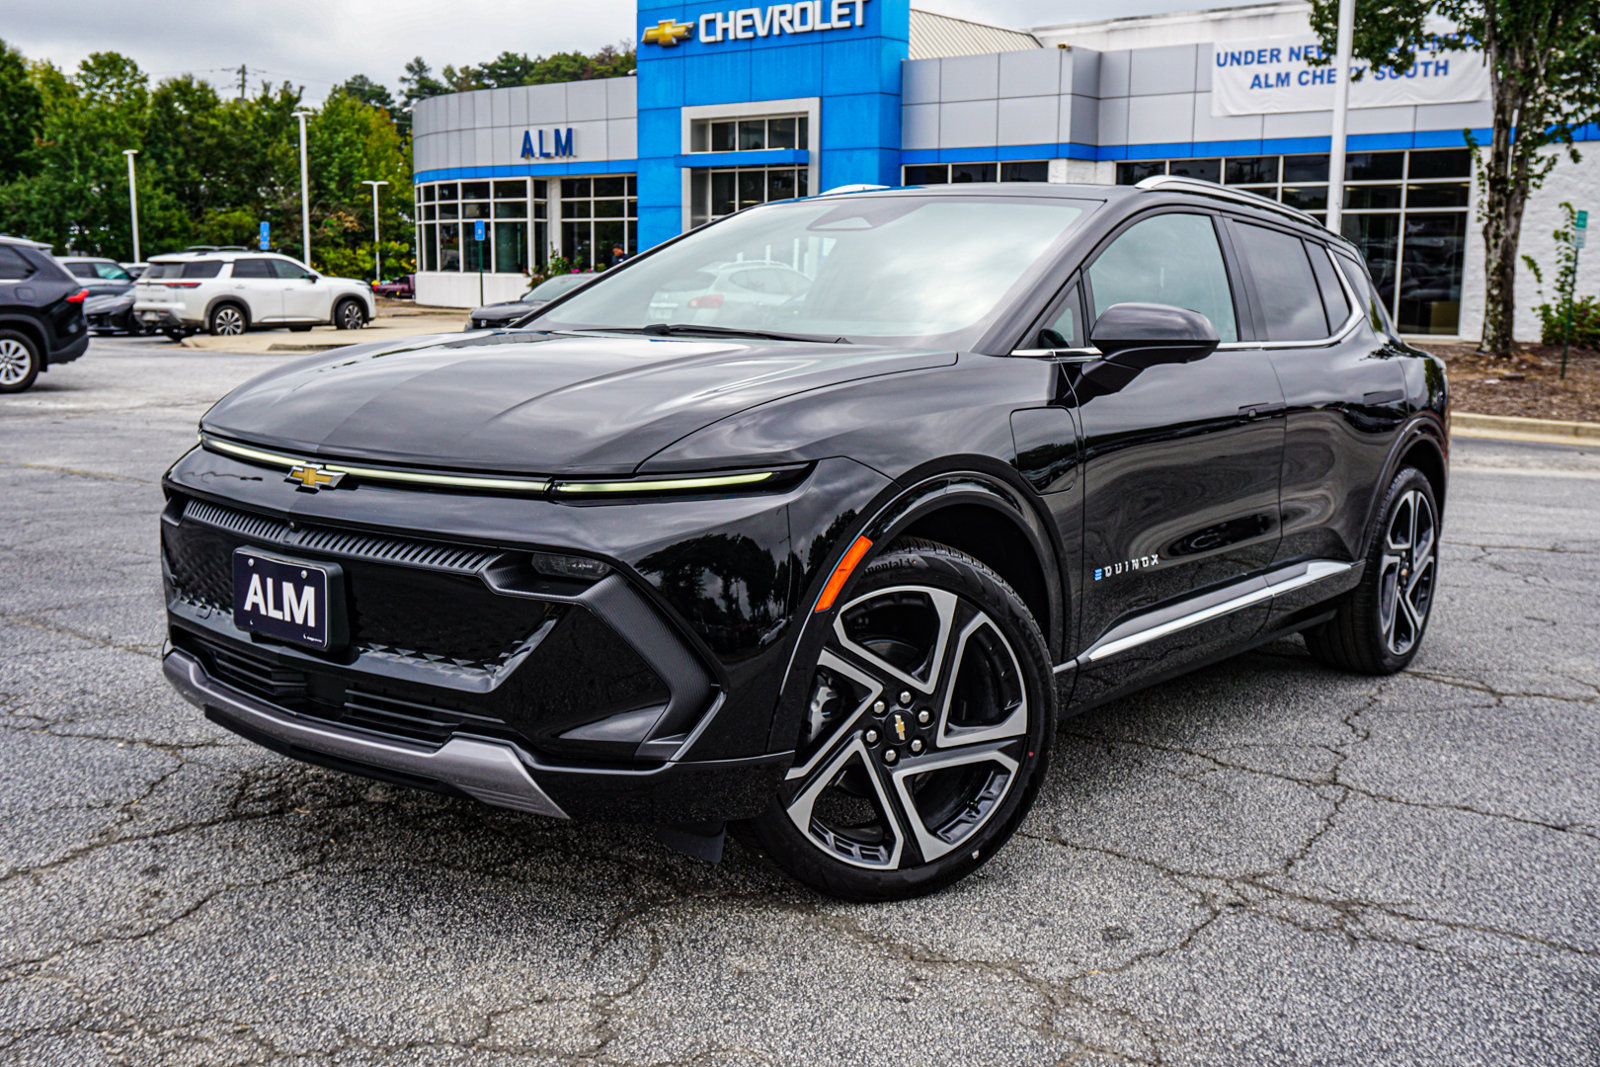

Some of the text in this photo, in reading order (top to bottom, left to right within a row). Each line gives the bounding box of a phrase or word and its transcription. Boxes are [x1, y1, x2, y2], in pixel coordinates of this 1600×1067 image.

[699, 0, 870, 43] CHEVROLET
[1216, 47, 1282, 67] UNDER
[1250, 59, 1450, 89] ALM CHEY SOUTH
[521, 128, 573, 158] ALM
[1094, 553, 1159, 581] EQUINOX
[243, 573, 316, 628] ALM
